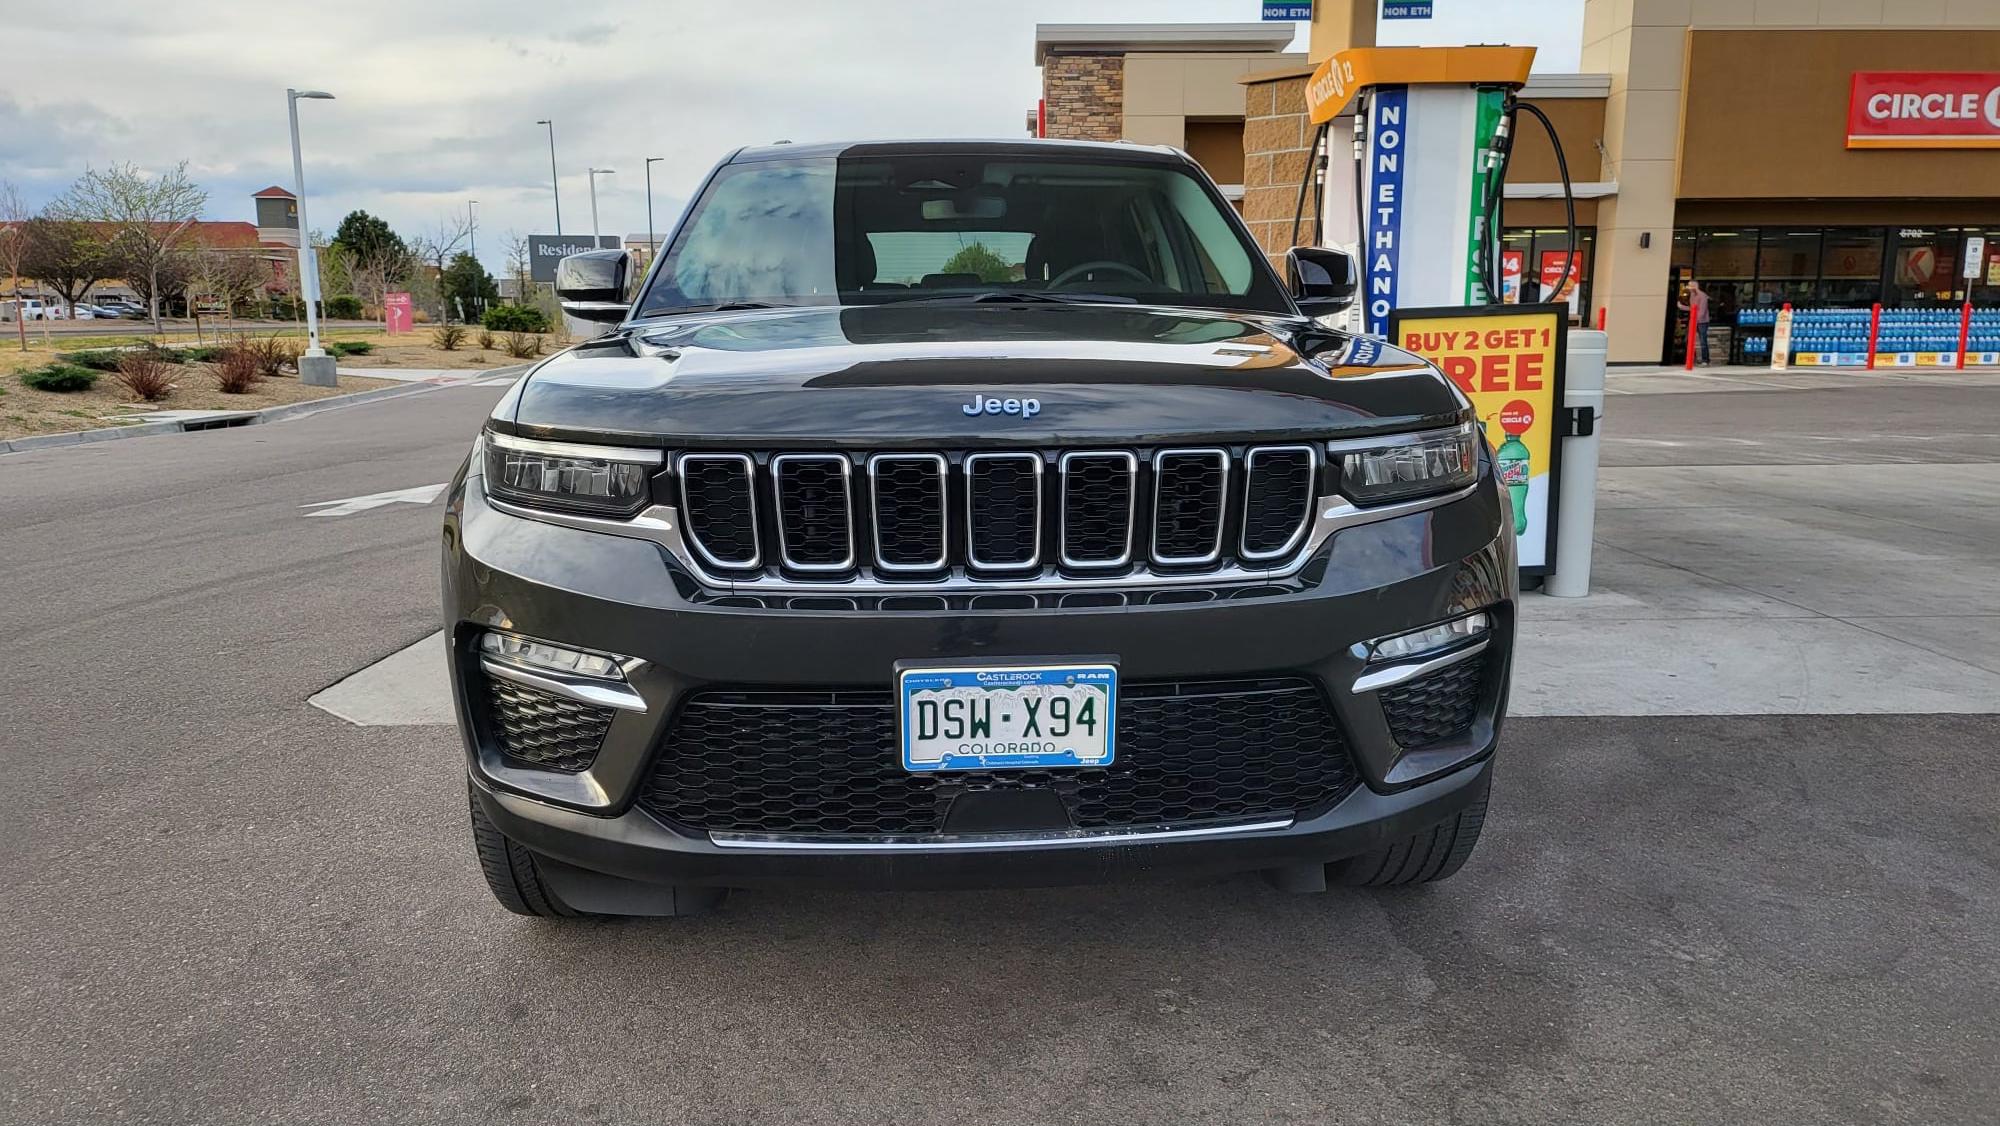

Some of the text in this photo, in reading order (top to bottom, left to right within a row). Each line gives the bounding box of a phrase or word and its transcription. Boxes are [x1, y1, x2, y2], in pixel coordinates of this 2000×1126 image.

[1264, 8, 1310, 17] NON ETH
[1384, 7, 1431, 16] NON ETH
[1311, 72, 1336, 107] CIRCLE
[1342, 60, 1354, 83] 12
[1868, 93, 1980, 119] CIRCLE
[1379, 106, 1400, 173] NON
[538, 243, 594, 256] Residen
[1405, 327, 1550, 352] BUY 2 GET 1
[1426, 353, 1544, 393] REE
[962, 394, 1041, 419] Jeep
[976, 672, 1042, 681] CASTLEROCK
[958, 742, 1056, 755] COLORADO
